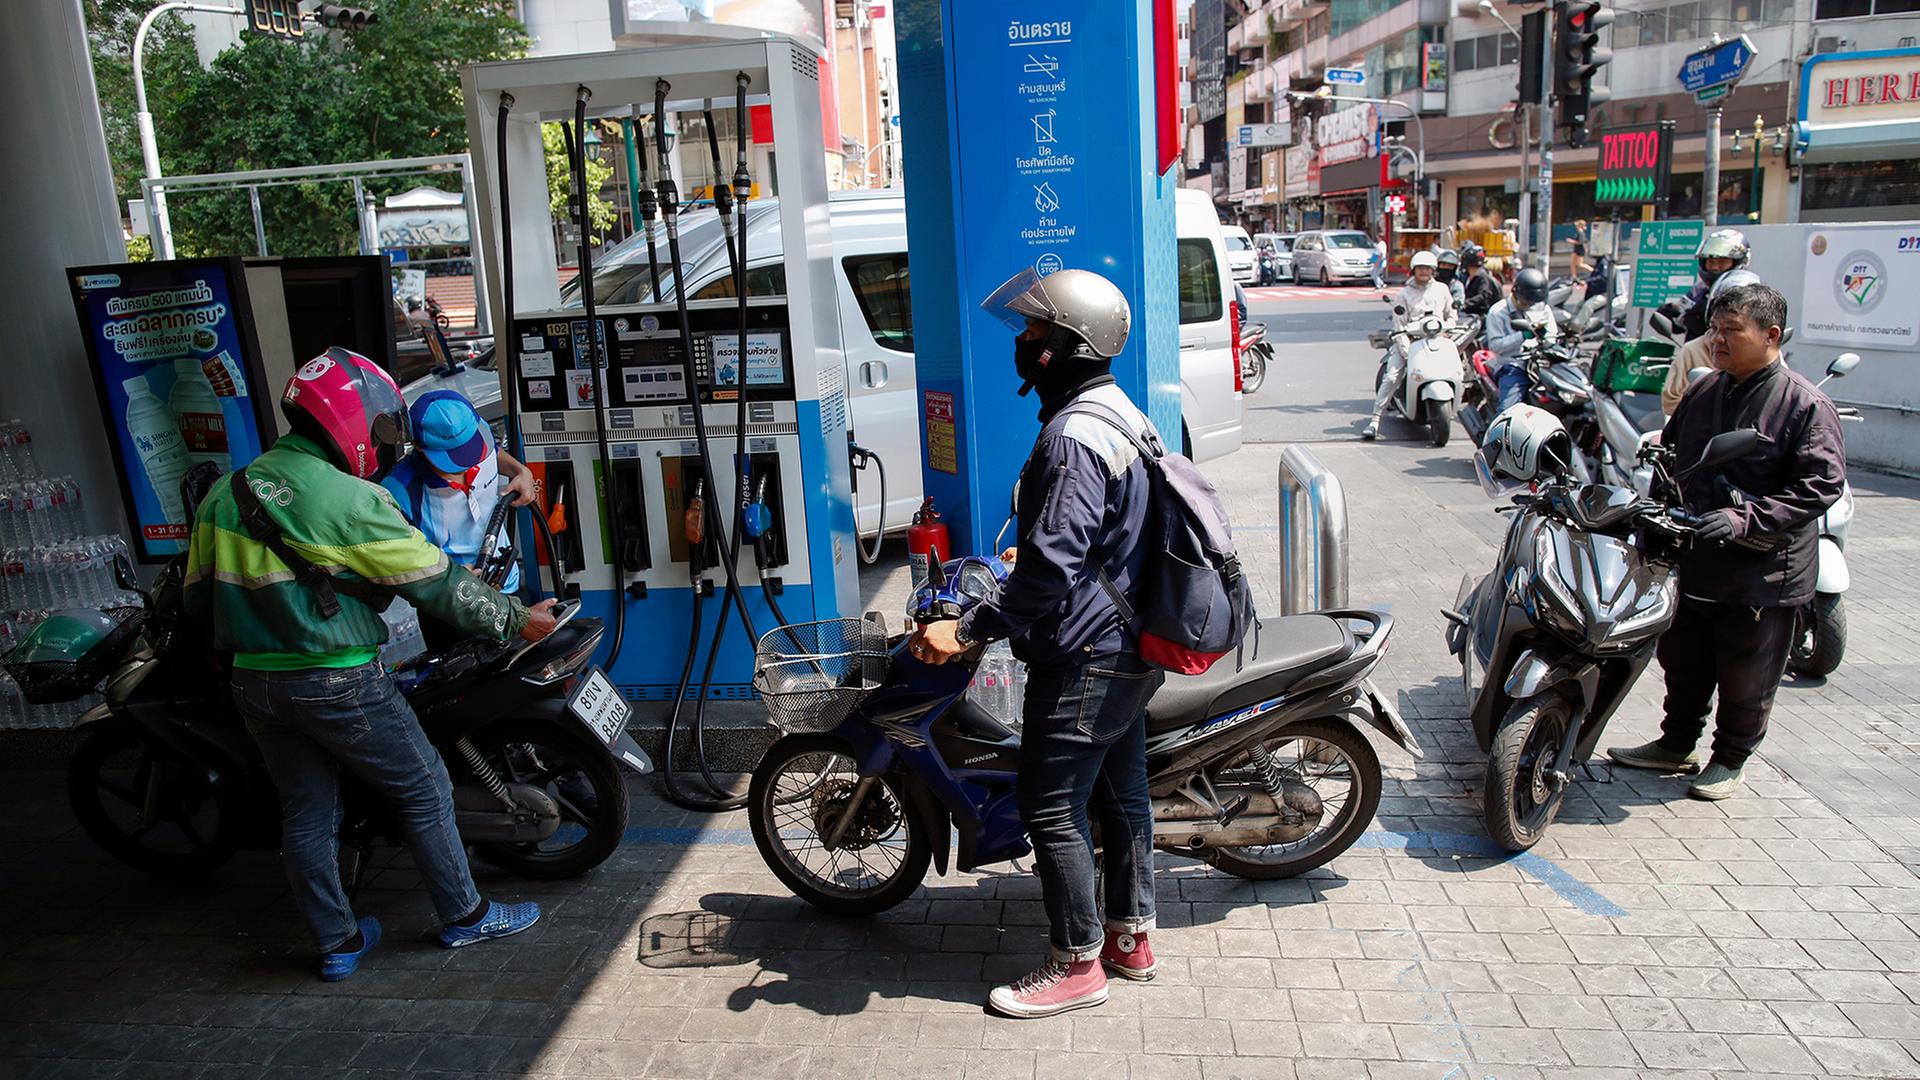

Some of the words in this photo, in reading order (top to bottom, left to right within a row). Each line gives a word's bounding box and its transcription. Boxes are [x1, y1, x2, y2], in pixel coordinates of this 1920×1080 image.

[1008, 21, 1071, 39] อันตราย
[1733, 48, 1741, 68] 4
[1018, 78, 1066, 96] ห้ามสูบบุหรี่
[1038, 145, 1051, 156] ปิด
[1602, 130, 1660, 171] TATTOO
[1016, 155, 1075, 169] โทรศัพท์มือถือ
[1039, 216, 1057, 227] ห้าม
[1021, 225, 1076, 238] ก่อประกายไฟ
[1040, 266, 1059, 274] STOP
[152, 294, 172, 306] 500
[175, 280, 211, 303] แถมน้ำ
[549, 324, 567, 334] 102
[151, 429, 177, 441] SINGHA
[457, 579, 507, 632] Grab
[601, 702, 625, 738] 8408
[964, 751, 999, 765] HONDA
